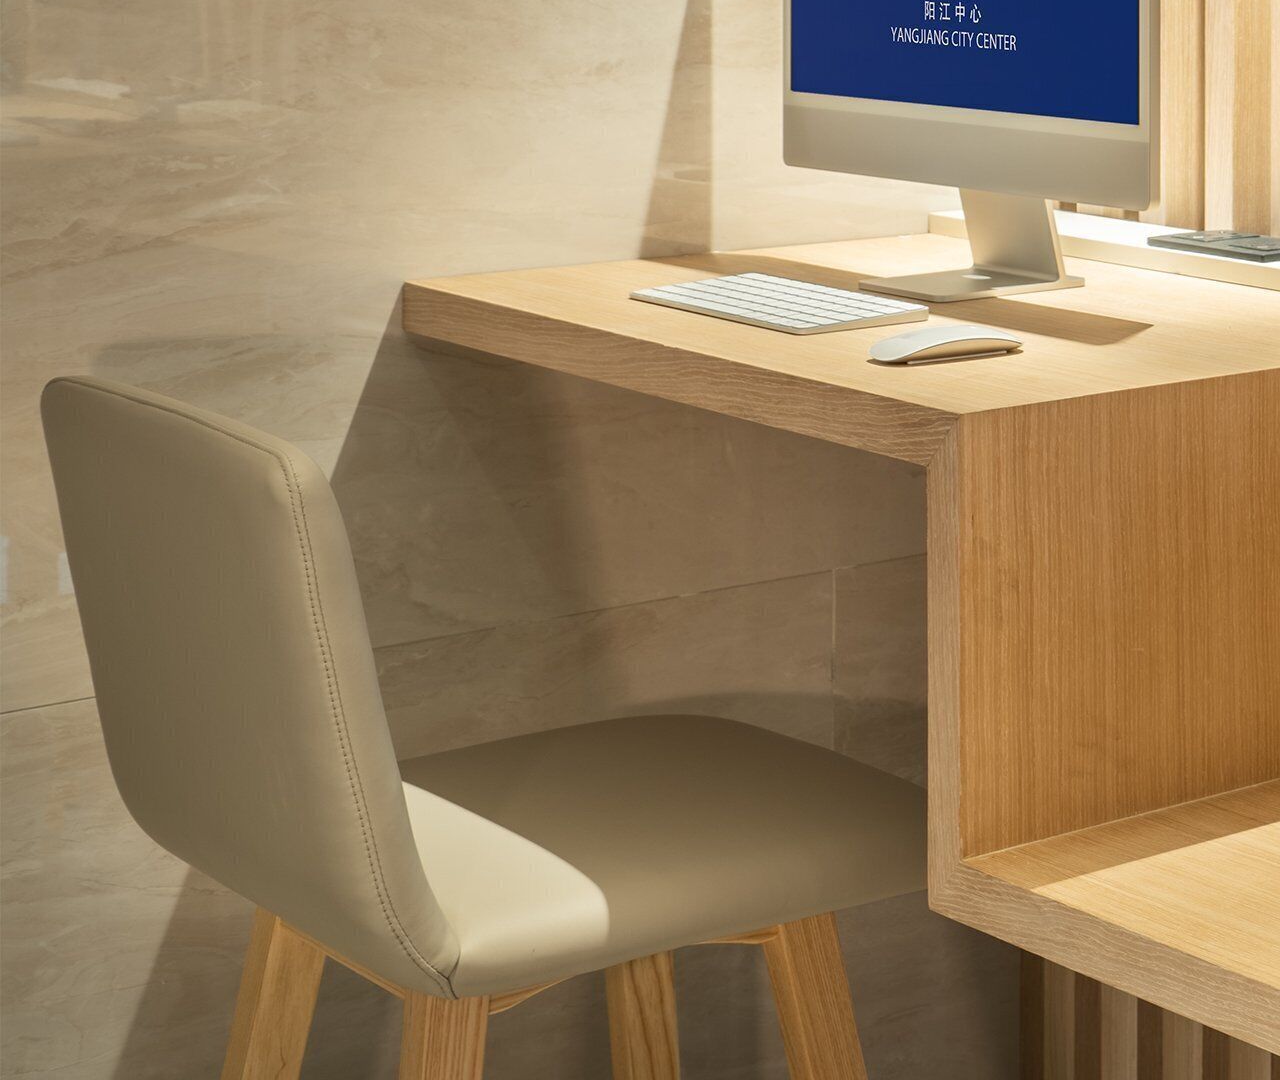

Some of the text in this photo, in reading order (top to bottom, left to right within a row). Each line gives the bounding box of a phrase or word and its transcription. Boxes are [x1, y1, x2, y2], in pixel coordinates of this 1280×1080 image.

[924, 0, 982, 23] 阳江中心
[890, 26, 1017, 51] YANGJIANG CITY CENTER
